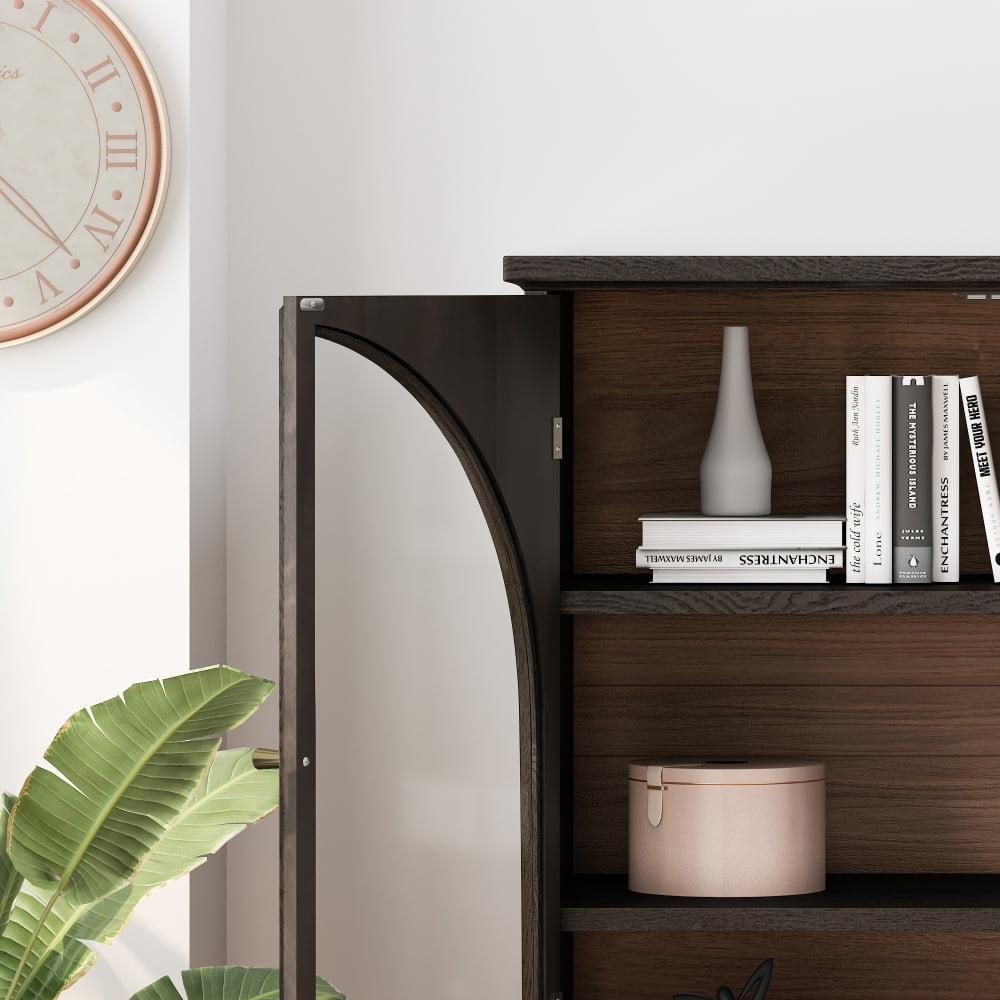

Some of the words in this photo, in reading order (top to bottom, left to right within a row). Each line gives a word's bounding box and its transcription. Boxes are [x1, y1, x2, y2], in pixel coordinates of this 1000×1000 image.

[908, 402, 917, 420] THE
[966, 394, 980, 421] HERO
[908, 422, 917, 475] MYSTERIOUS
[970, 421, 986, 450] YOUR
[943, 452, 949, 461] BY
[977, 451, 991, 478] MEET
[908, 478, 917, 509] ISLAND
[849, 502, 864, 527] wife
[940, 477, 949, 574] ENCHANTRESS
[849, 530, 861, 553] cold
[873, 532, 883, 566] Lone
[686, 554, 712, 562] JAMES
[739, 554, 835, 566] ENCHANTRESS
[849, 556, 861, 573] the
